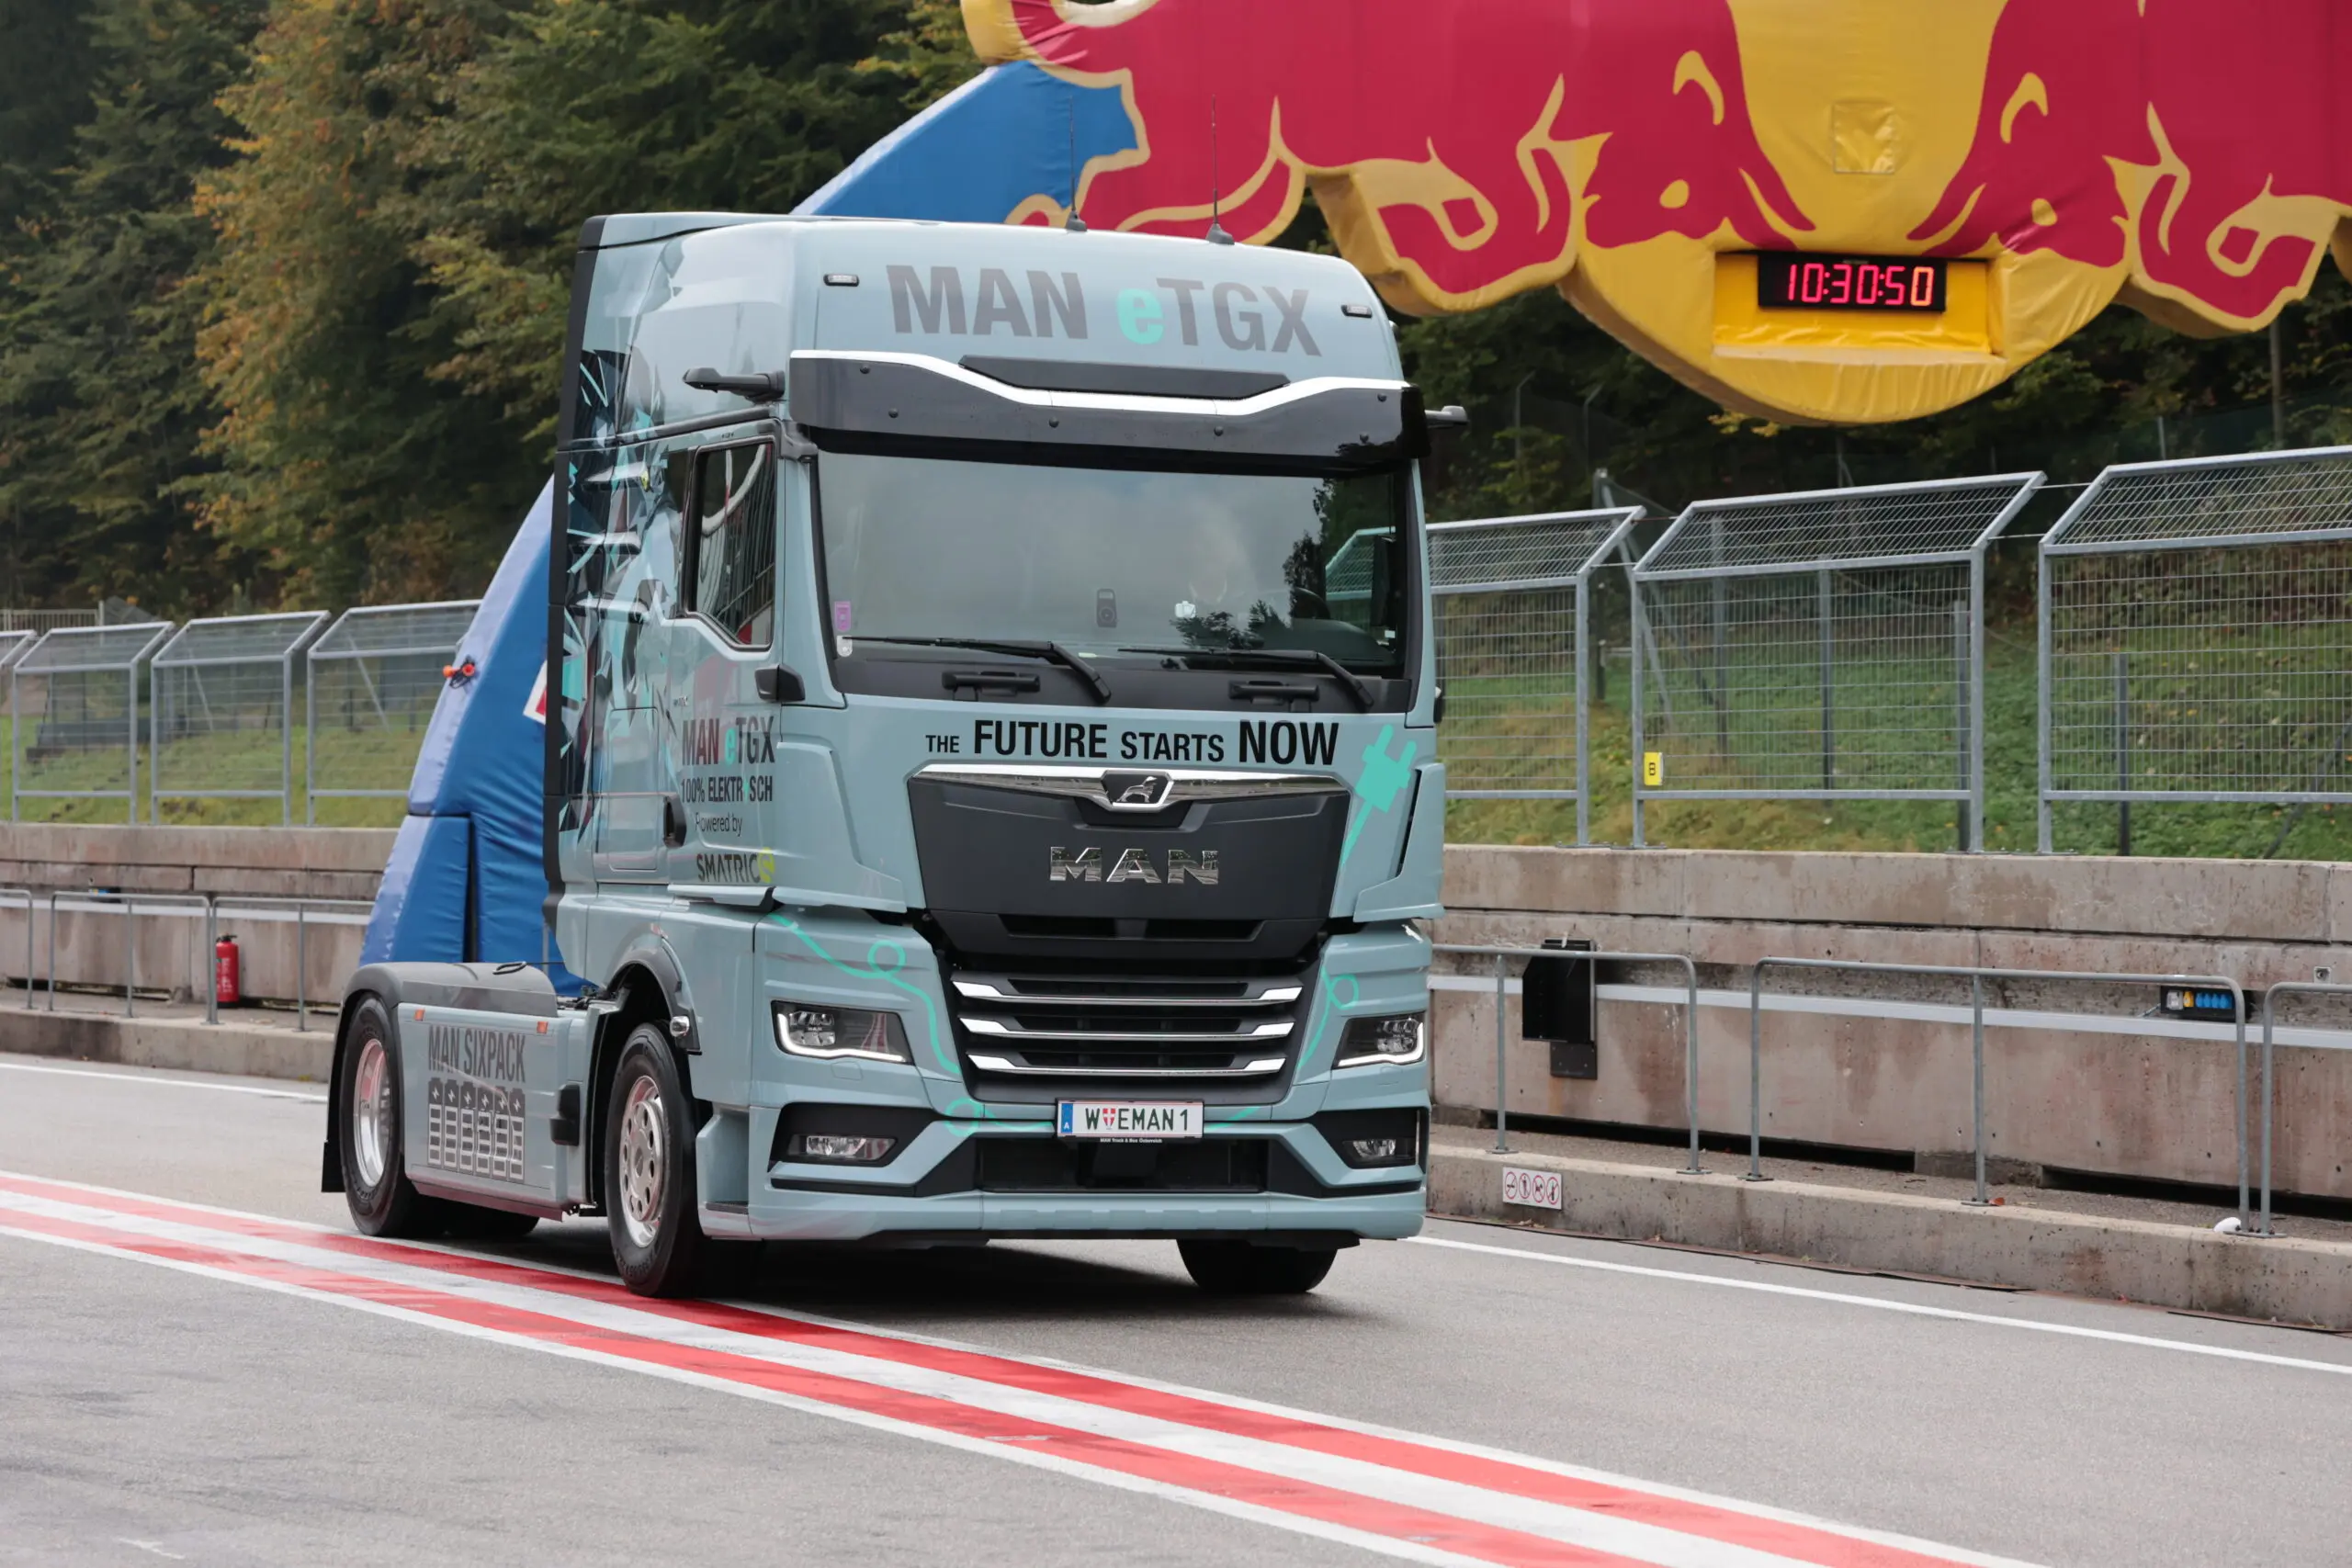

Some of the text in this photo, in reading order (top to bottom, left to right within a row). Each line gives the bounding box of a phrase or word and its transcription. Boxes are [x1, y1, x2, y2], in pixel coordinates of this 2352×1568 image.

[1788, 263, 1934, 306] 10:30:50
[886, 265, 1323, 357] MAN eTGX
[682, 716, 775, 767] MAN eTGX
[925, 719, 1340, 765] THE FUTURE STARTS NOW
[681, 779, 706, 803] 100%
[695, 812, 742, 836] Powered by
[1049, 846, 1219, 885] MAN
[428, 1024, 526, 1083] MAN SIXPACK
[1085, 1108, 1100, 1131] W
